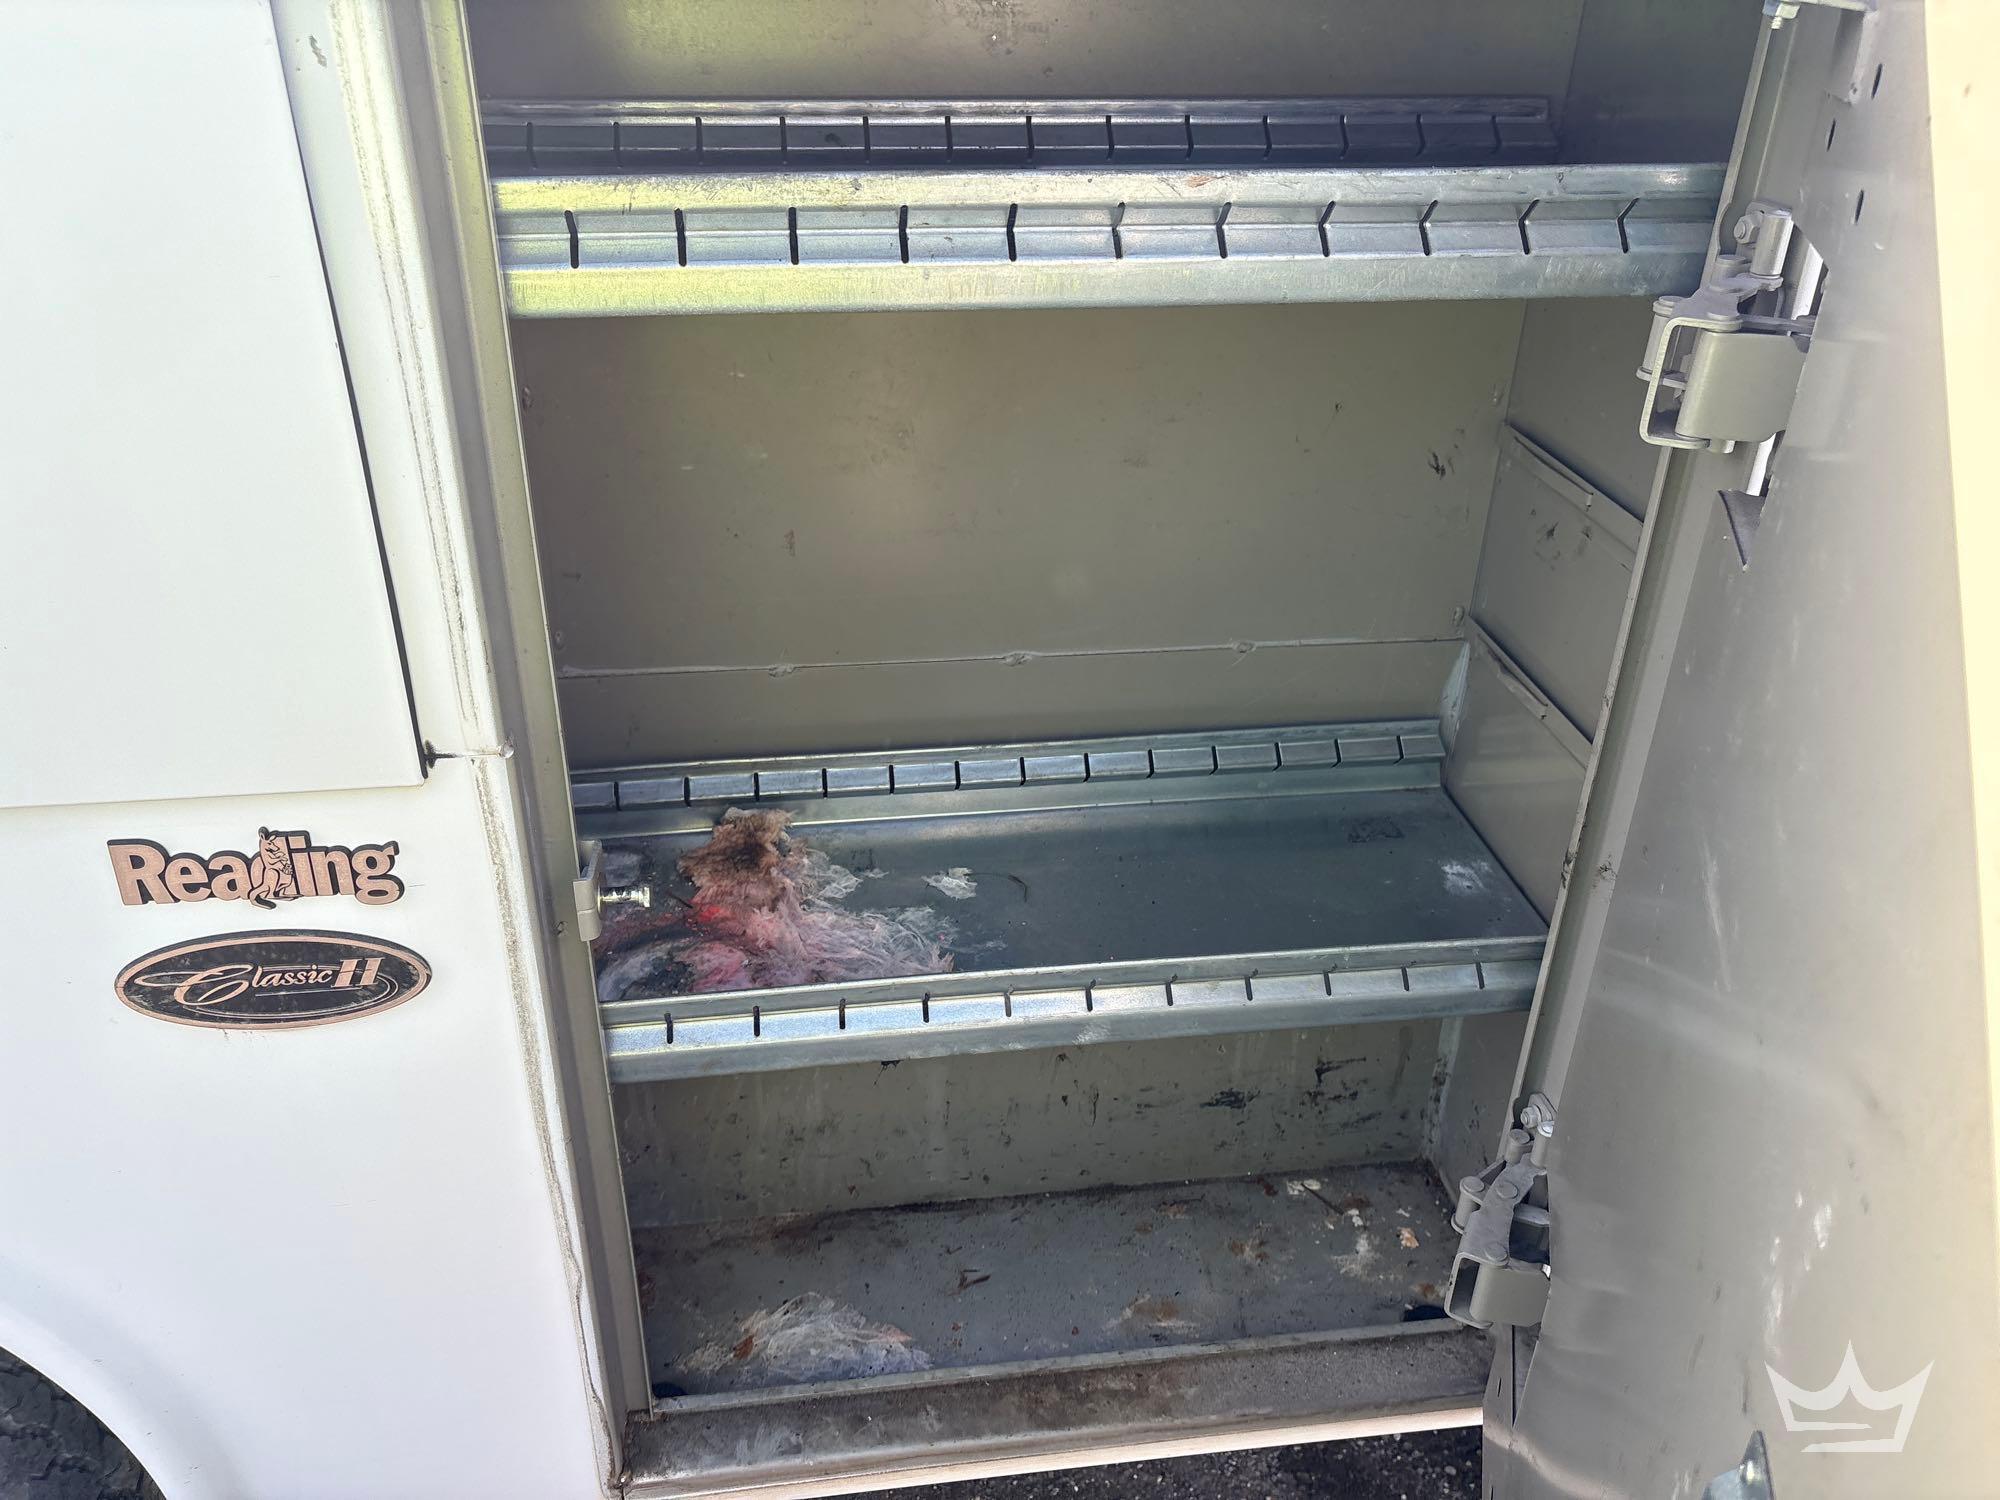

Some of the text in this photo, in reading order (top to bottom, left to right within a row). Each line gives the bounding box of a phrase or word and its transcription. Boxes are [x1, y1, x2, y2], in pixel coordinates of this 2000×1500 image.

[107, 829, 404, 906] Reading
[134, 957, 384, 1006] Classic II
